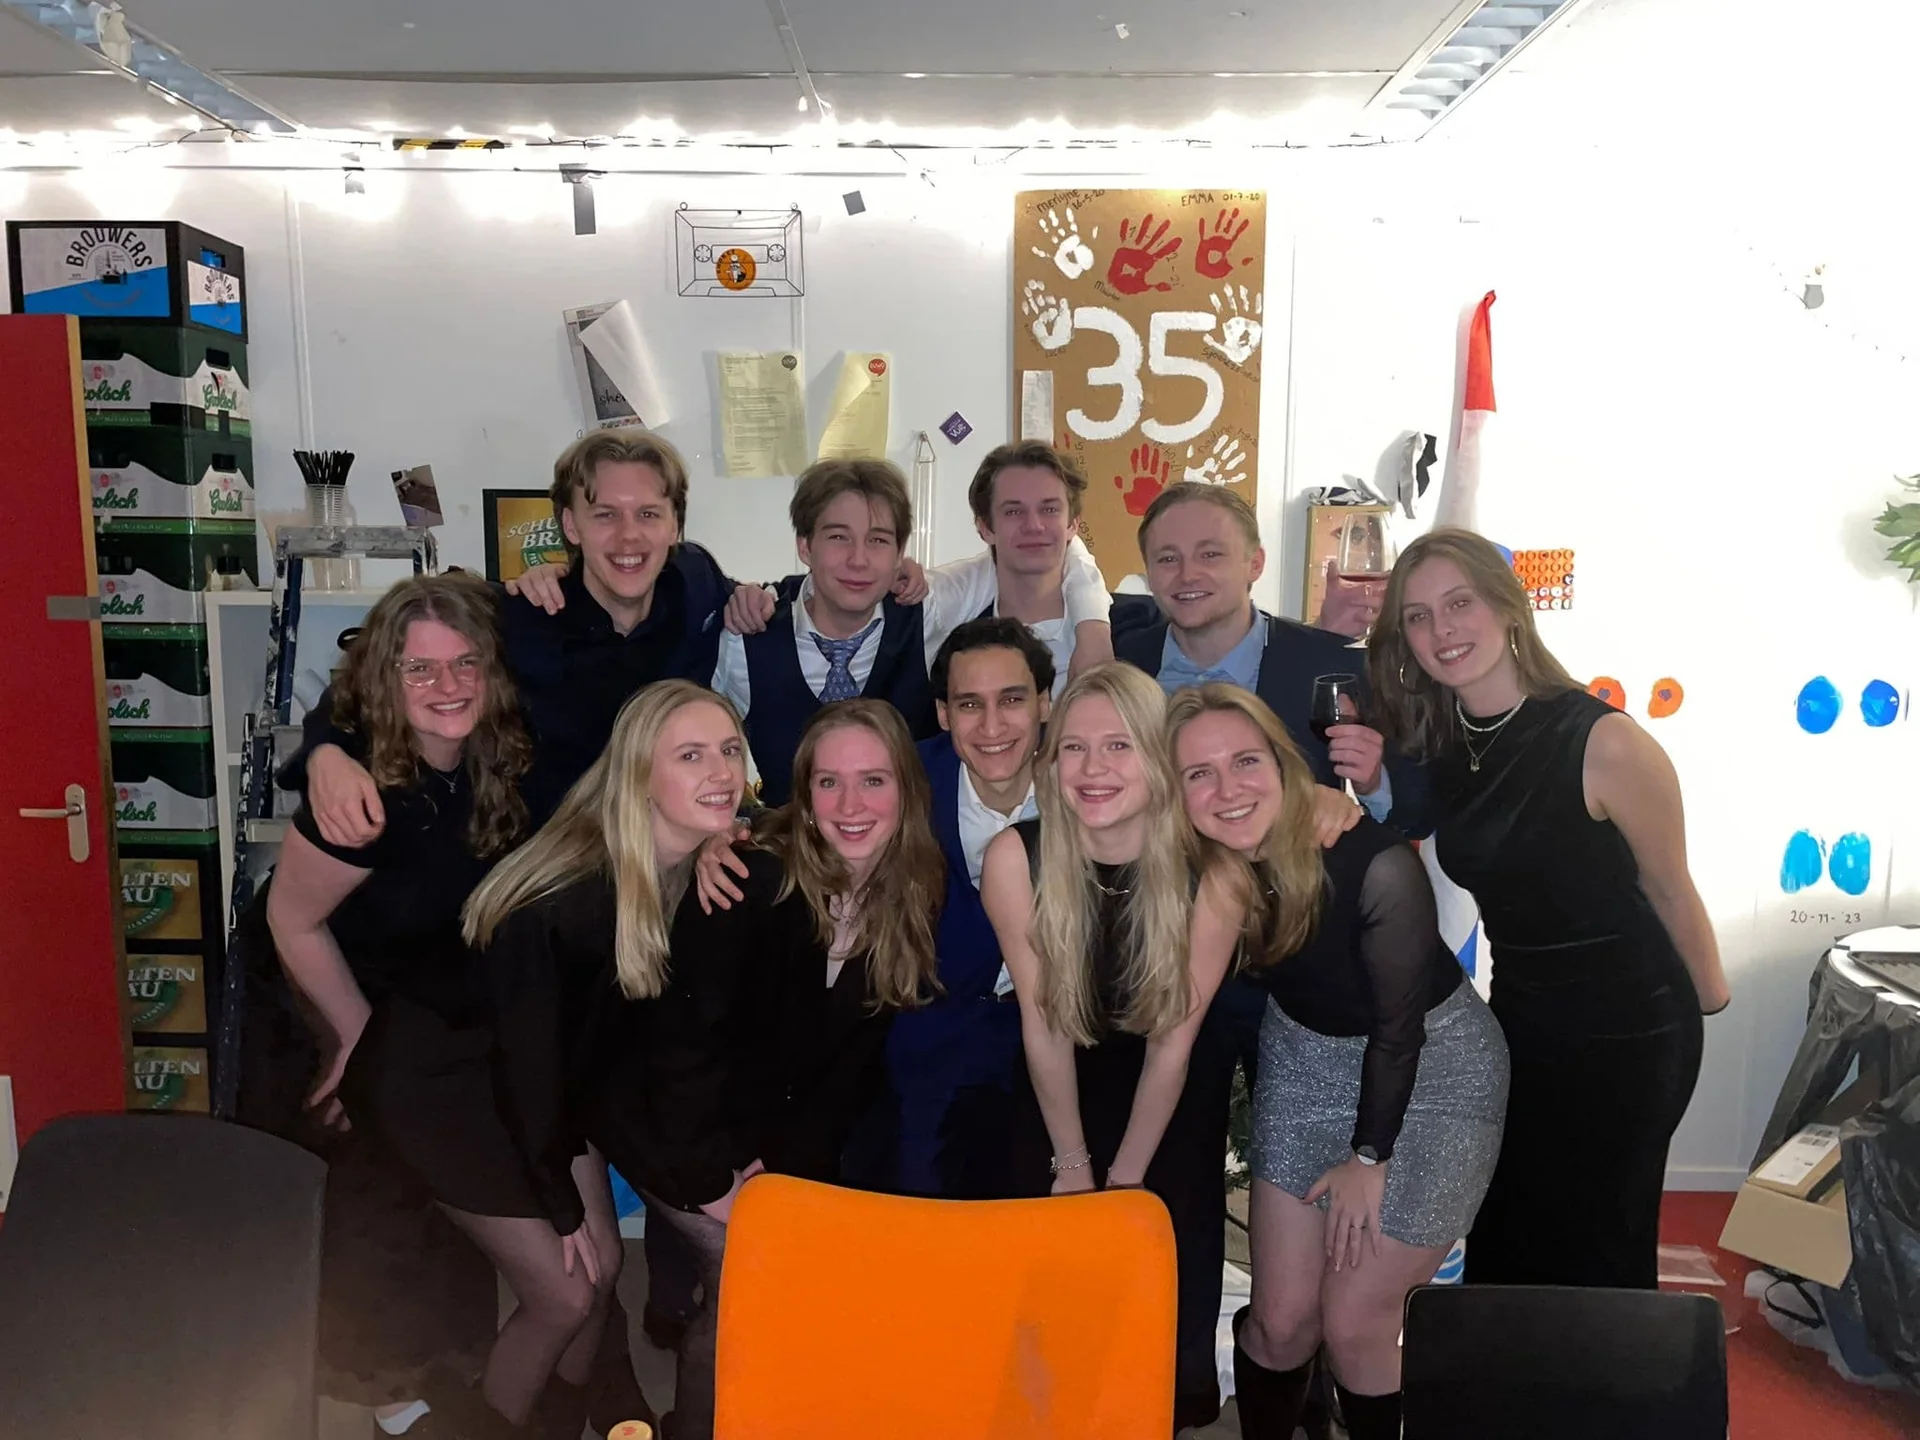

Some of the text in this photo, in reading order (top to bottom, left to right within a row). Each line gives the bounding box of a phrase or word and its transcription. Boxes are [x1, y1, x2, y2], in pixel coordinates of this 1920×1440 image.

[1181, 192, 1214, 207] EMMA
[66, 227, 153, 268] BROUWERS
[204, 268, 235, 300] BROUWERS
[1065, 306, 1224, 444] 35
[84, 378, 131, 402] olsch
[92, 487, 138, 510] olsch
[521, 531, 561, 549] BR
[100, 593, 144, 615] olsch
[107, 698, 150, 719] olsch
[115, 800, 157, 821] olsch
[122, 871, 192, 888] LTEN
[128, 967, 196, 982] LTEN
[134, 1060, 200, 1075] LTEN
